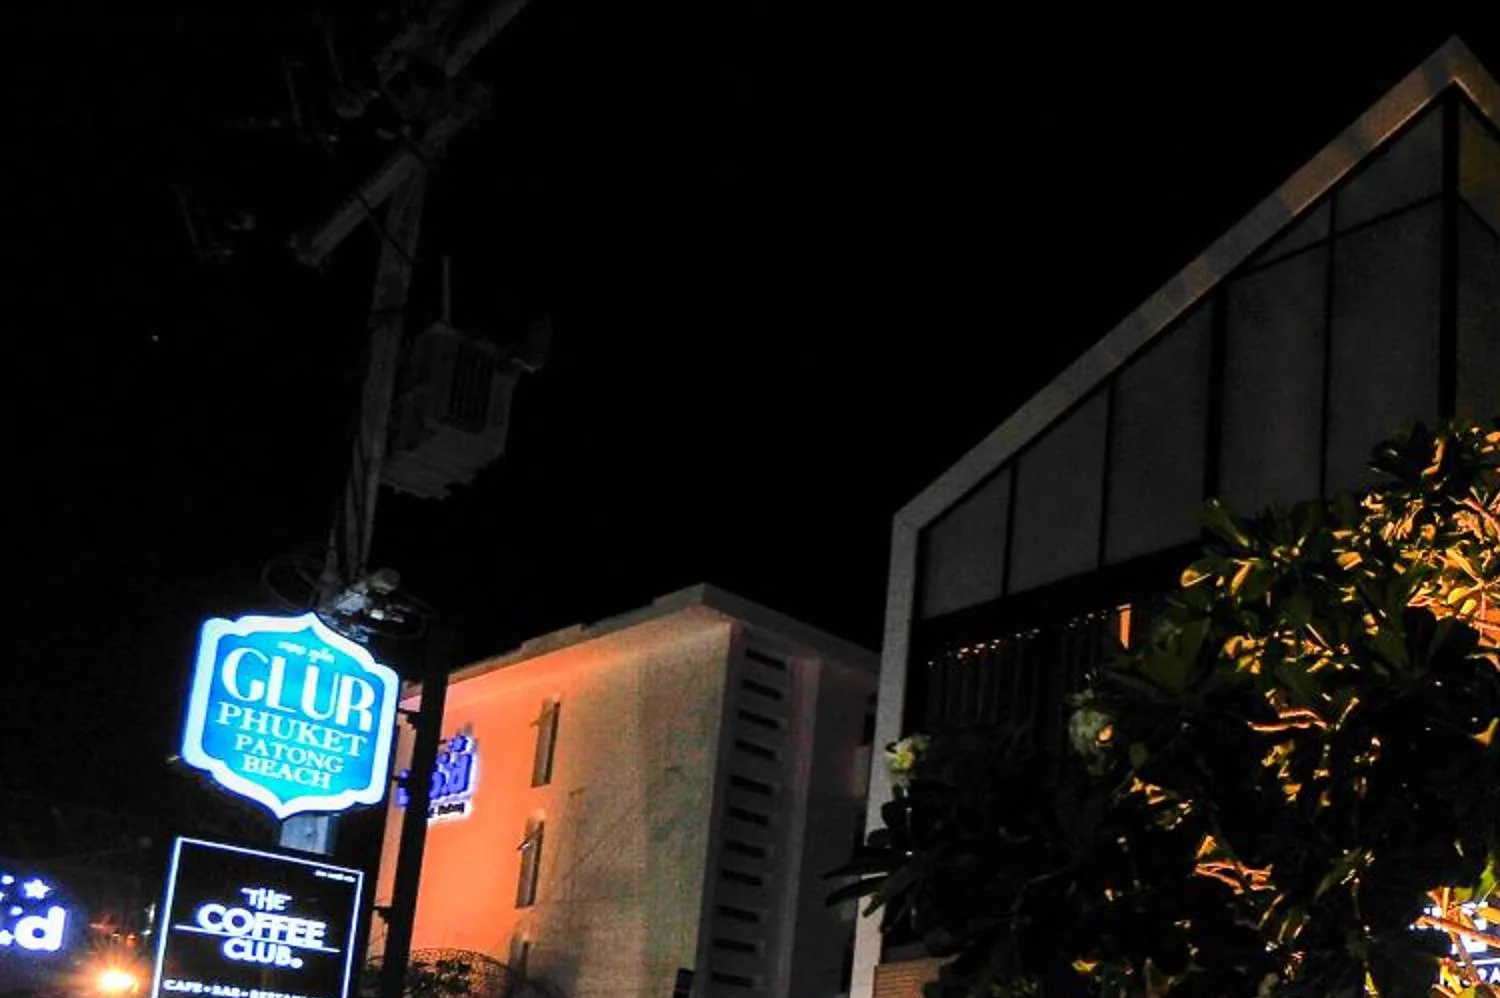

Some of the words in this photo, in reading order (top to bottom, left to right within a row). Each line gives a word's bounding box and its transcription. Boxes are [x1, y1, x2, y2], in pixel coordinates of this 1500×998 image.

[221, 647, 376, 732] GLUR
[215, 701, 368, 758] PHUKET
[234, 733, 345, 774] PATONG
[242, 755, 333, 789] BEACH
[241, 888, 293, 911] THE
[197, 903, 327, 948] COFFEE
[212, 985, 242, 998] BAR
